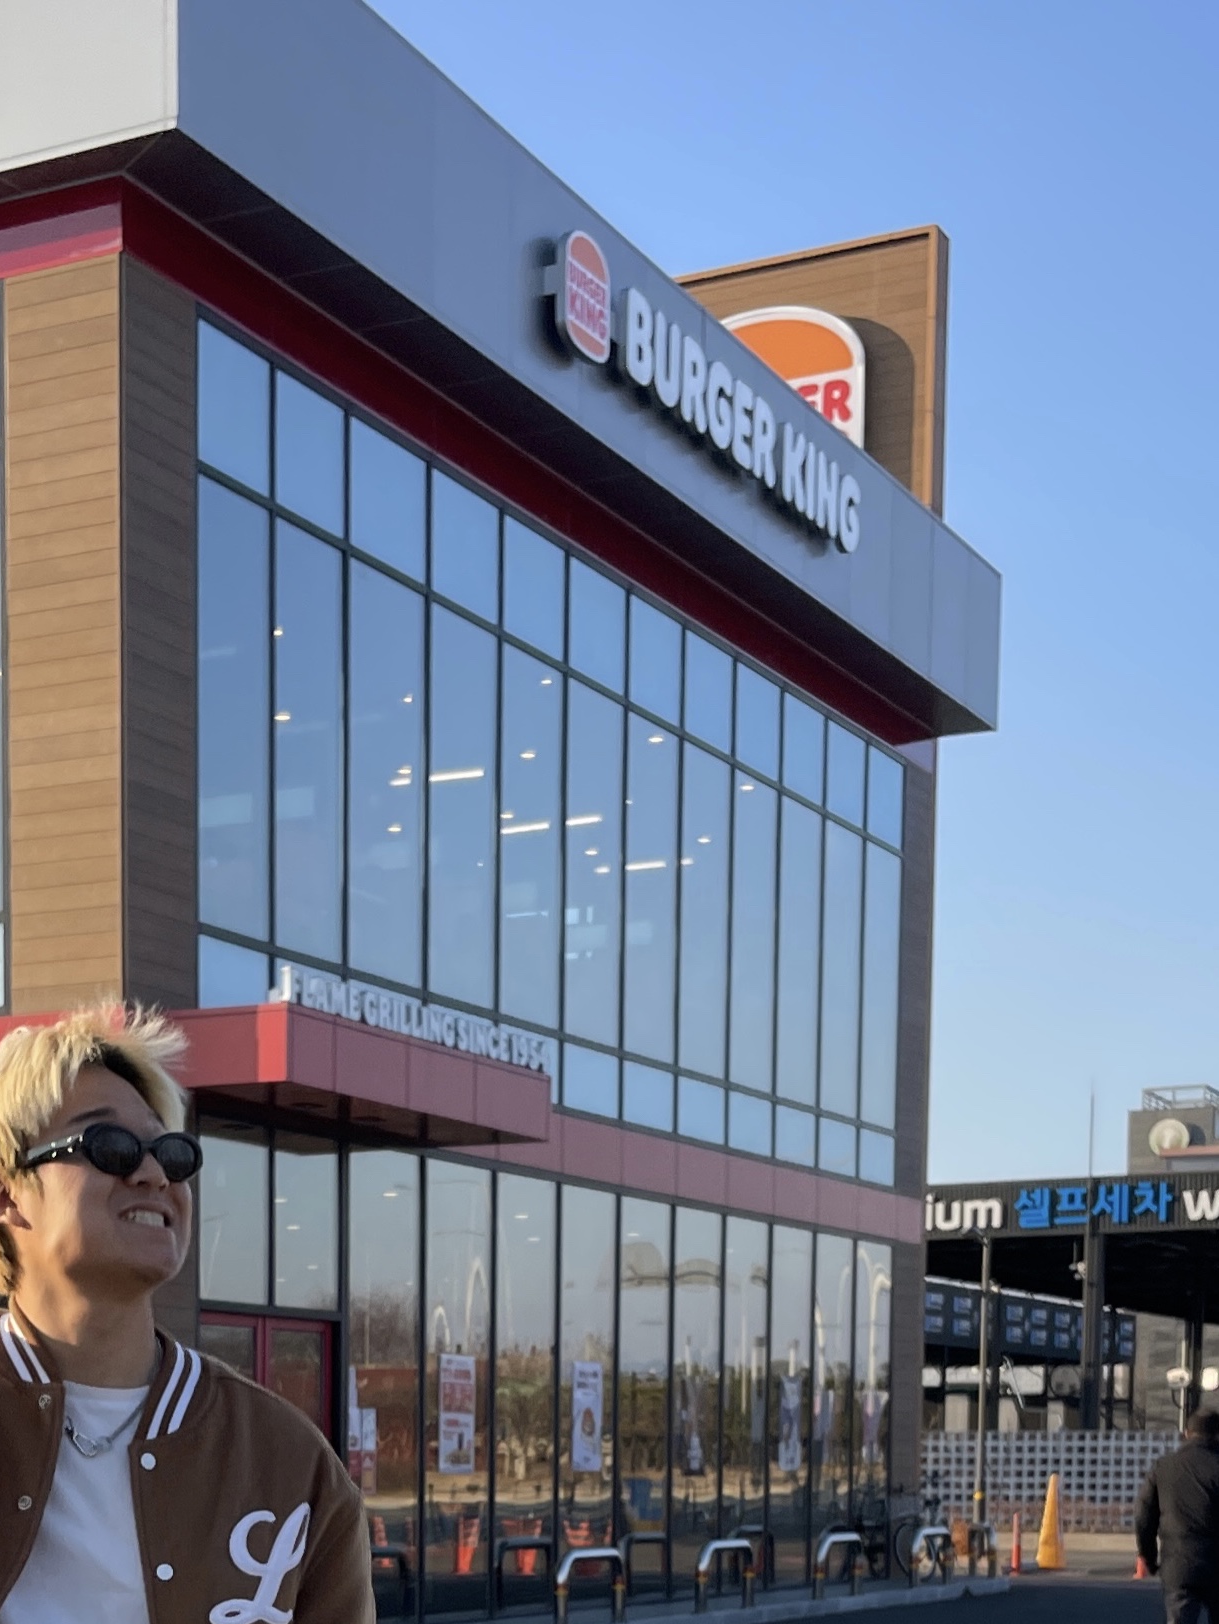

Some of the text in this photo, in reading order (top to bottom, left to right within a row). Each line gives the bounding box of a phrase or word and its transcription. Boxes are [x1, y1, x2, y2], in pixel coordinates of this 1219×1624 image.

[569, 286, 607, 340] KING
[626, 288, 861, 552] BURGER KING
[364, 990, 456, 1049] GRILLING
[457, 1015, 510, 1063] SINCE
[511, 1033, 549, 1074] 1954
[925, 1193, 1003, 1231] ium
[1014, 1181, 1173, 1229] 셀프세차
